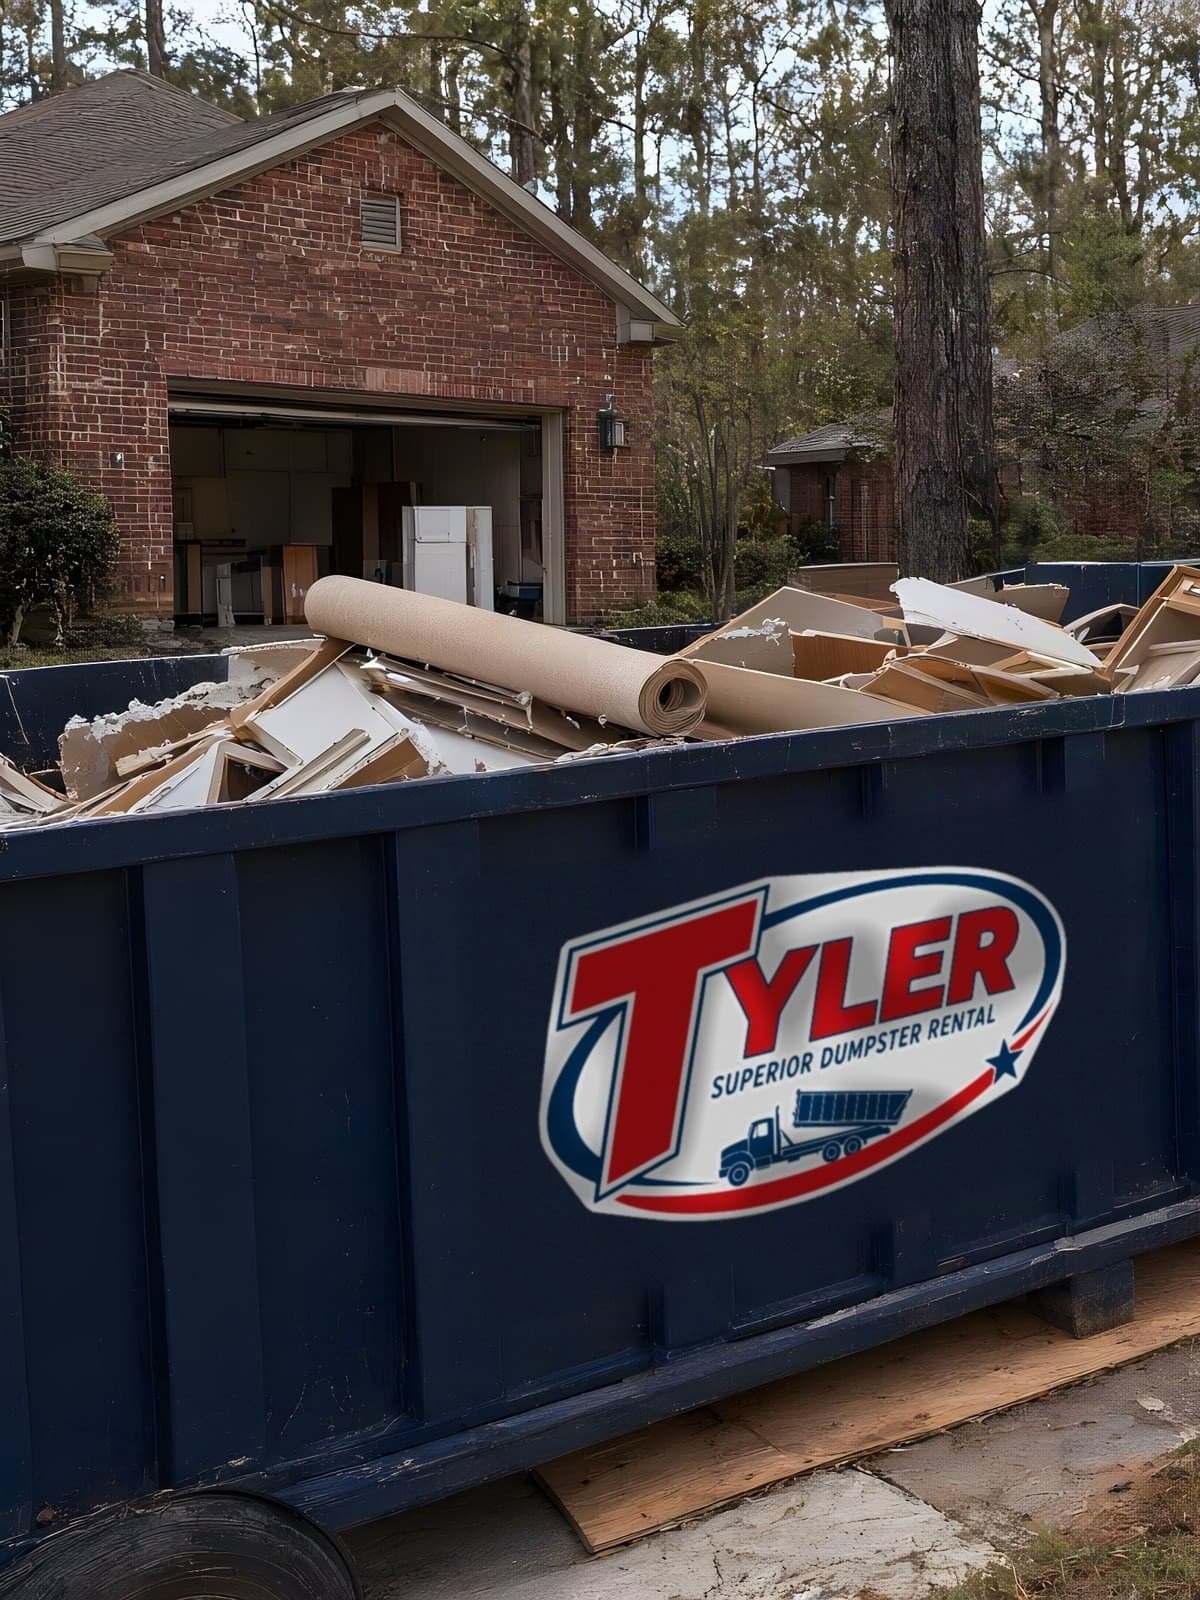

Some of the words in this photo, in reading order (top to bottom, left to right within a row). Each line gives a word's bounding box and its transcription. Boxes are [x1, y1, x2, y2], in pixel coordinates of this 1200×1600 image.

[566, 896, 1021, 1188] TYLER
[711, 1053, 812, 1099] SUPERIOR
[820, 1027, 923, 1069] DUMPSTER
[927, 1004, 996, 1040] RENTAL
